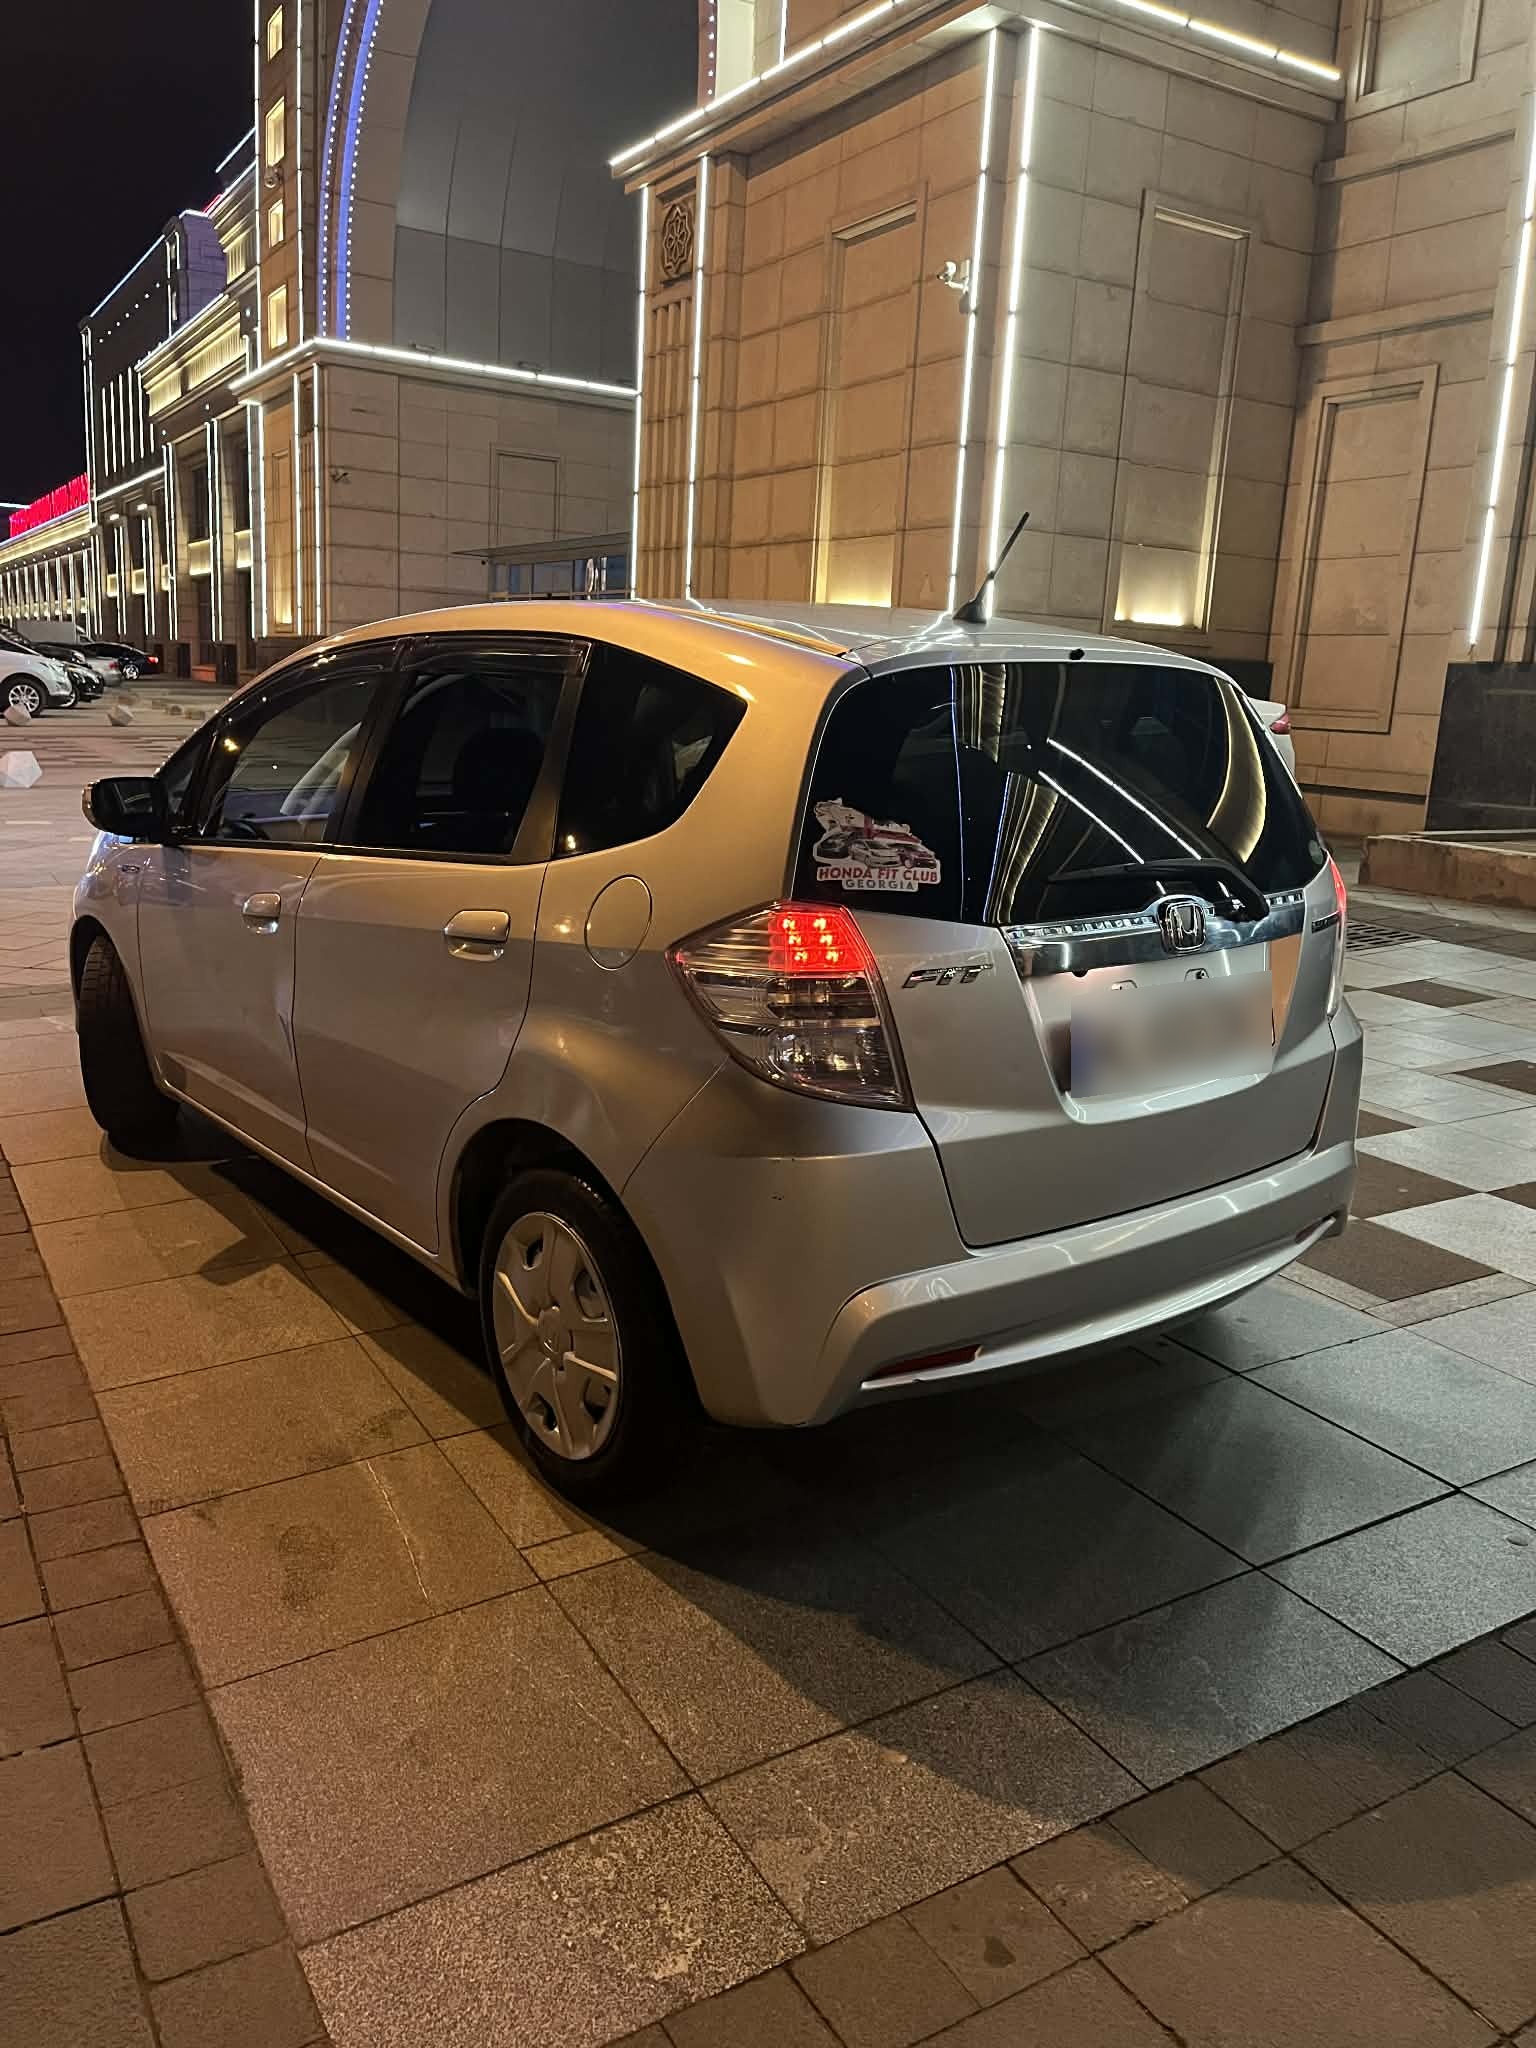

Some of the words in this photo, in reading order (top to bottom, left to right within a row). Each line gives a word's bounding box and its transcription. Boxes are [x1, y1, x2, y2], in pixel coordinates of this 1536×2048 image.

[818, 867, 873, 880] HONDA
[876, 869, 899, 880] FIT
[903, 870, 938, 883] CLUB
[845, 879, 915, 891] GEORGIA
